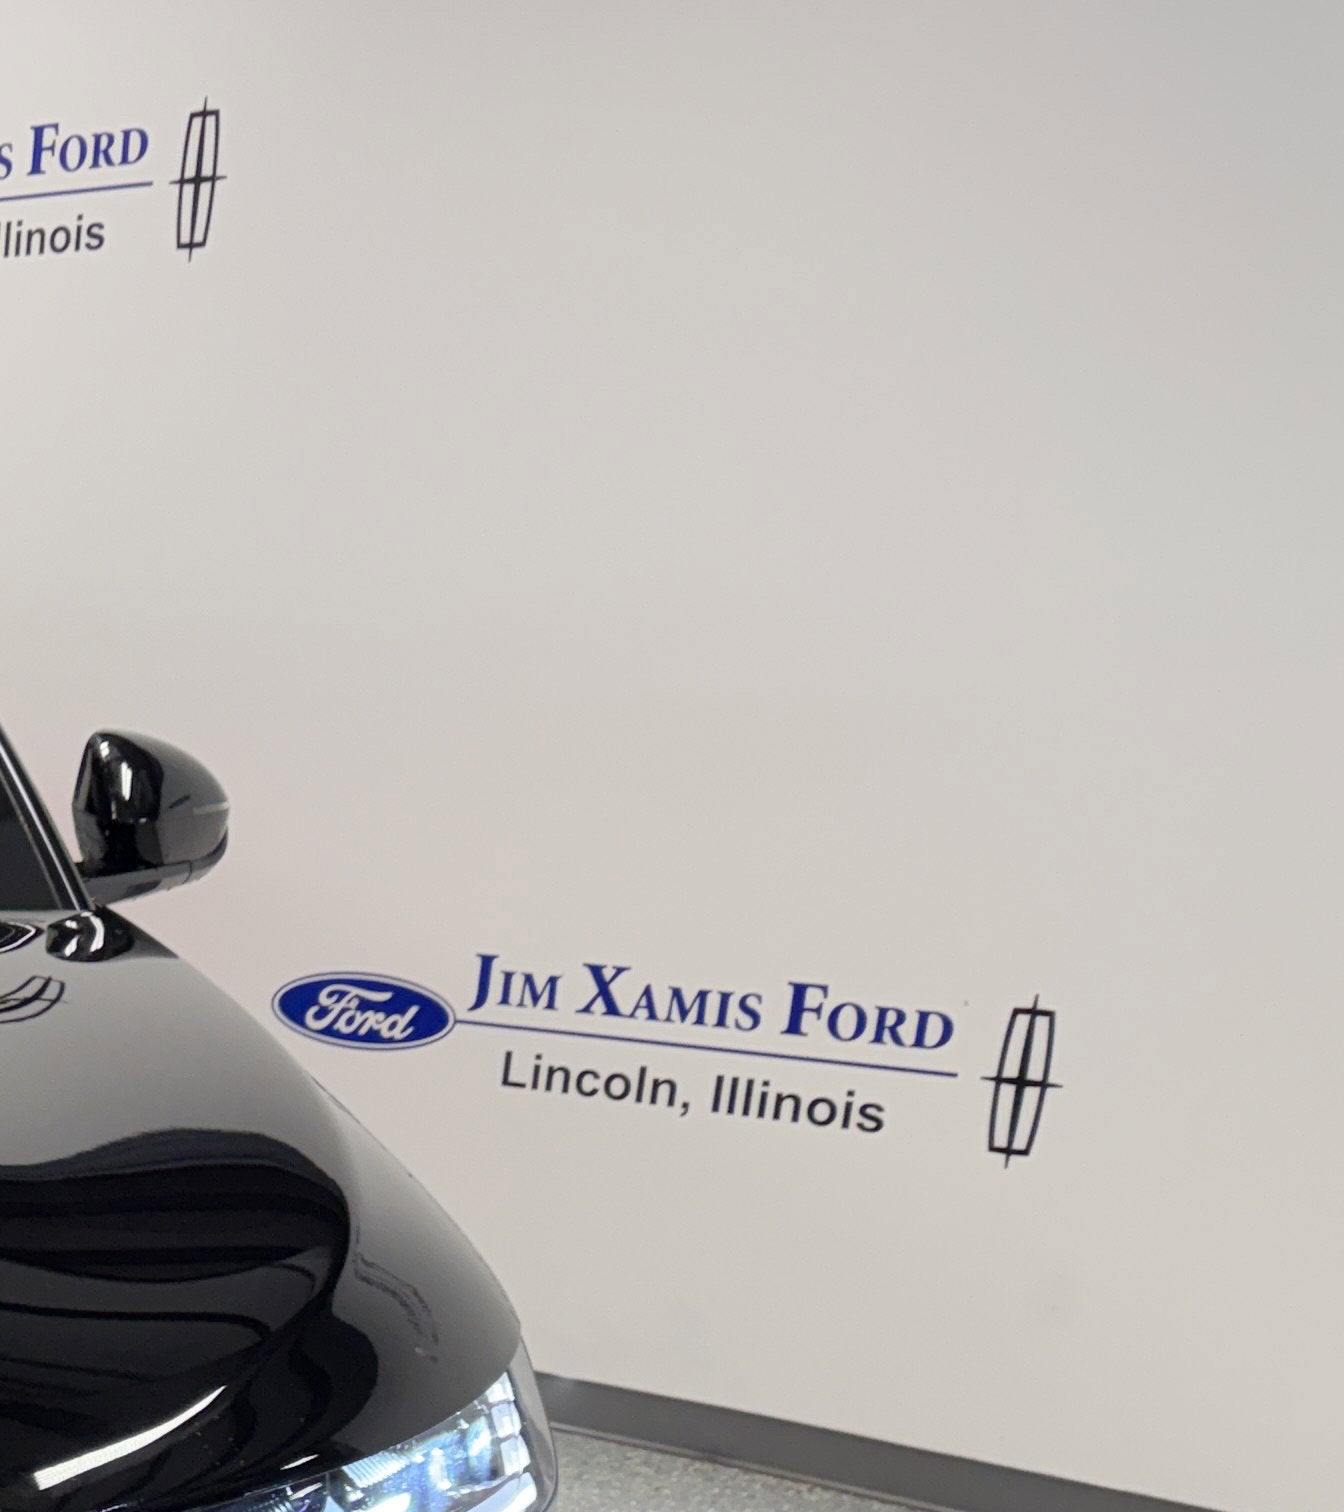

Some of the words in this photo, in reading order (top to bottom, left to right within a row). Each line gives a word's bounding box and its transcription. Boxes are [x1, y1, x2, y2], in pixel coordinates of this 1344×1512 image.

[27, 123, 148, 176] FORD
[305, 983, 414, 1042] Ford
[468, 954, 561, 1011] JIM
[579, 963, 762, 1032] XAMIS
[780, 982, 955, 1050] FORD
[501, 1050, 691, 1117] Lincoln,
[712, 1075, 884, 1133] Illinois
